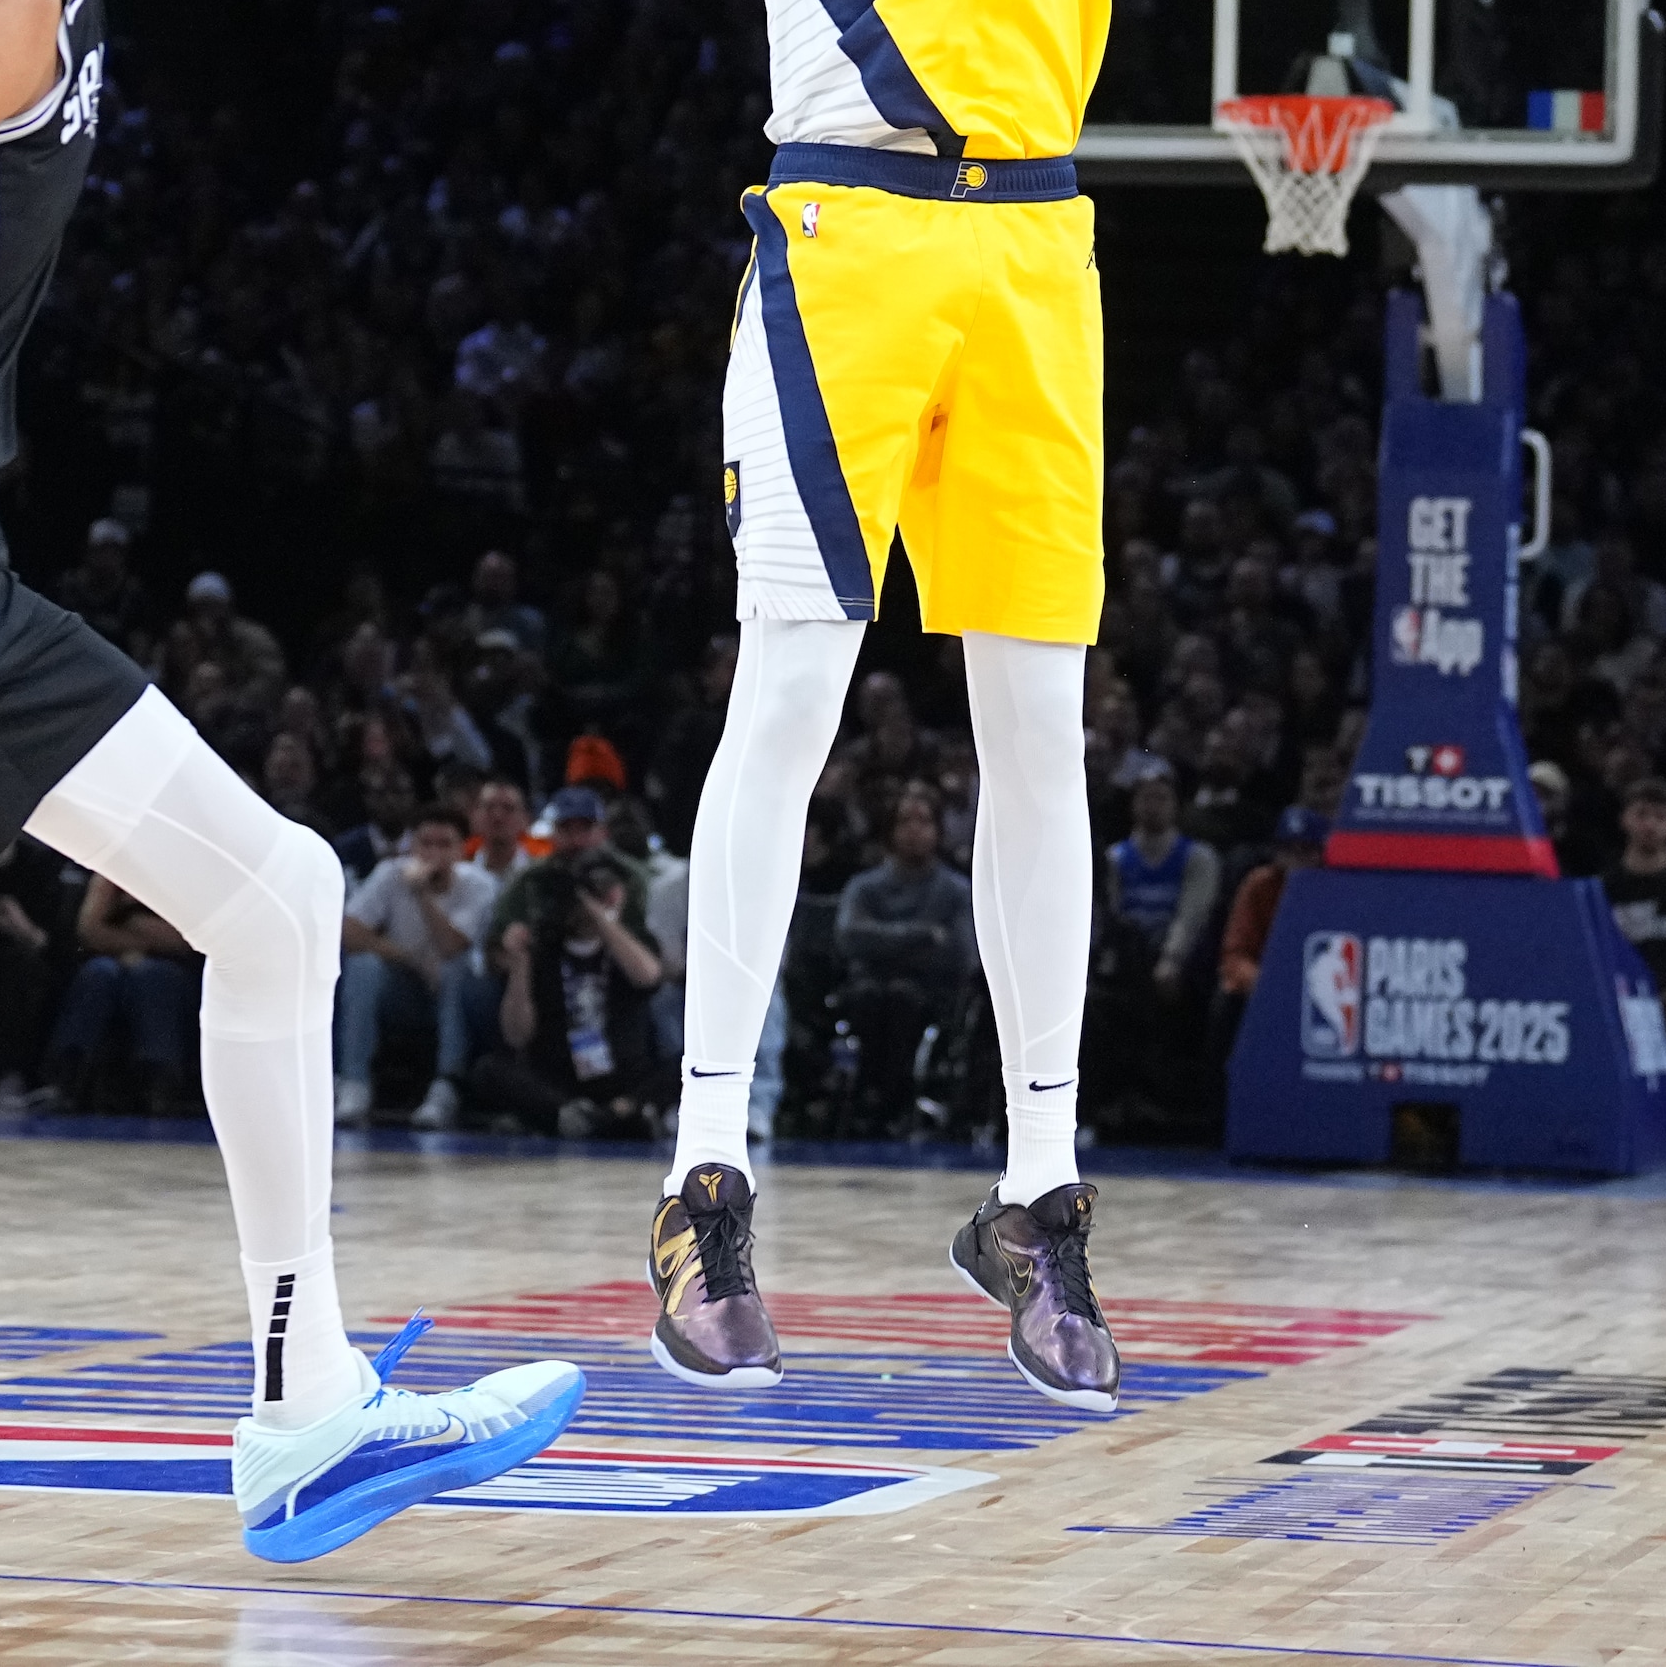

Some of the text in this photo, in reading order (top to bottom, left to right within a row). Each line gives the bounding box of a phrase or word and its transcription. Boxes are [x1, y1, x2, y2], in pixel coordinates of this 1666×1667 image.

[1407, 496, 1473, 550] GET
[1406, 552, 1472, 608] THE
[1353, 772, 1514, 811] TISSOT
[1367, 935, 1469, 998] PARIS
[1477, 998, 1573, 1067] 2025
